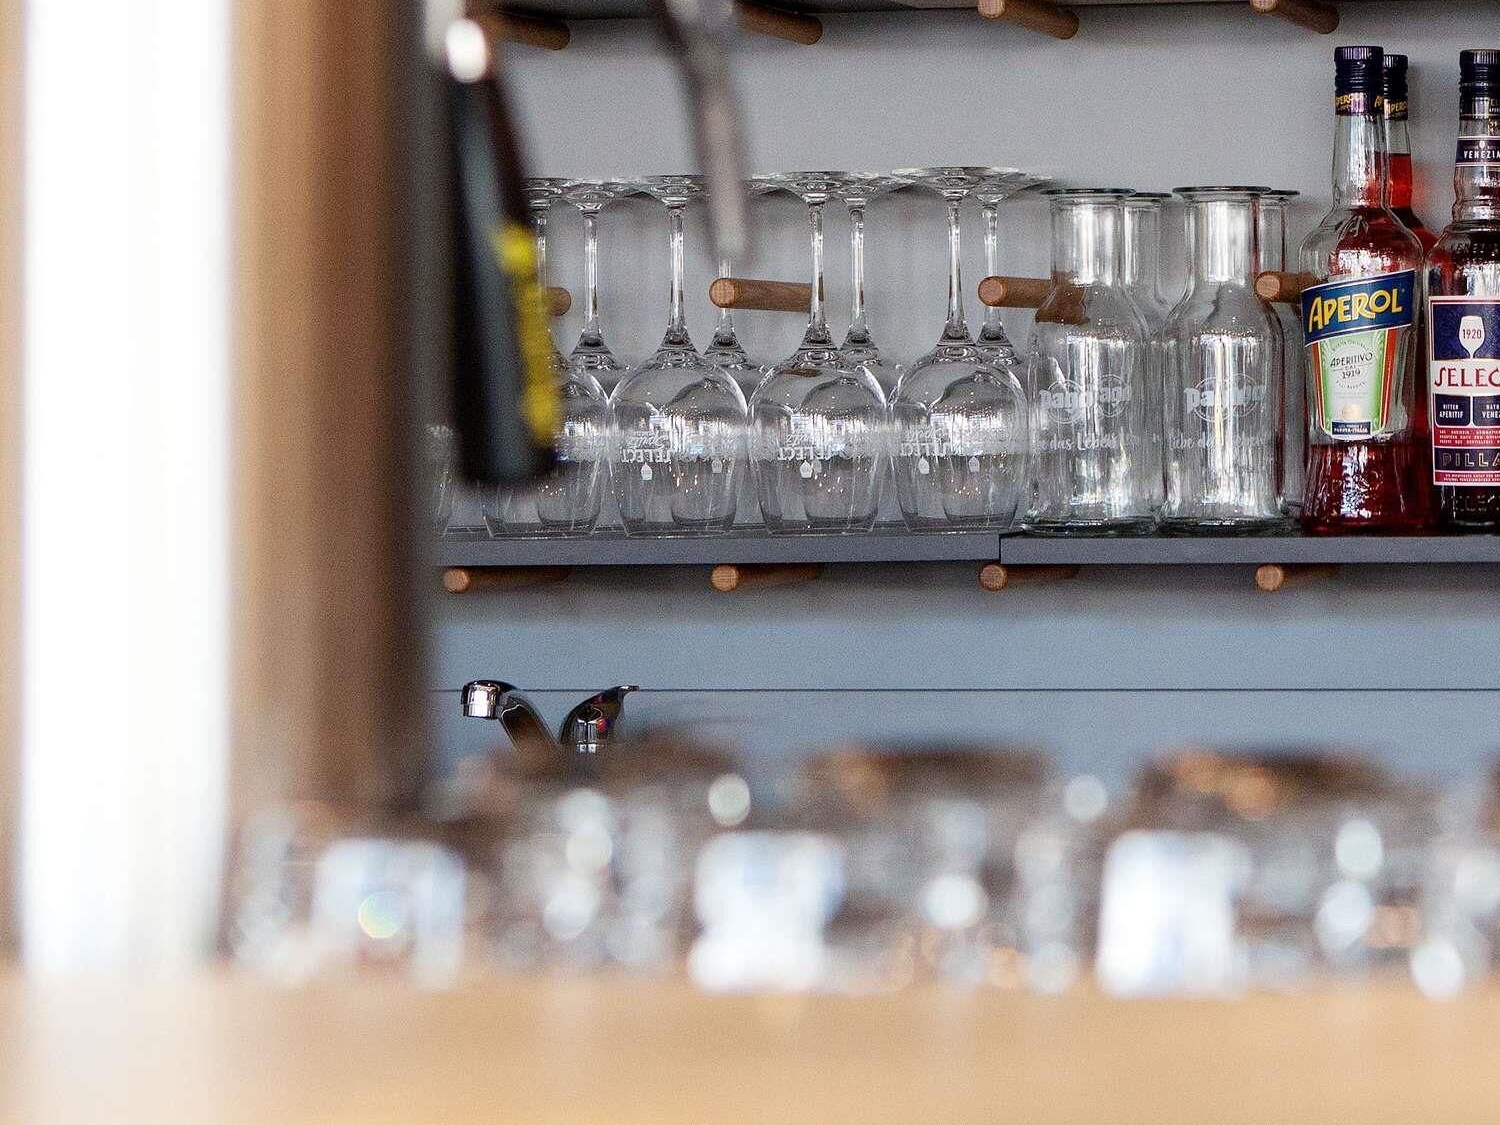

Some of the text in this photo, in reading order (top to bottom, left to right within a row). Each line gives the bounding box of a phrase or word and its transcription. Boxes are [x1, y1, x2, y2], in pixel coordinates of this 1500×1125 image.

[1463, 150, 1500, 159] VENEZIA
[1308, 288, 1403, 333] APEROL
[1462, 328, 1482, 340] 1920
[1330, 352, 1373, 368] APERITIVO
[1341, 369, 1361, 380] 1919
[1440, 411, 1464, 419] APERITIF
